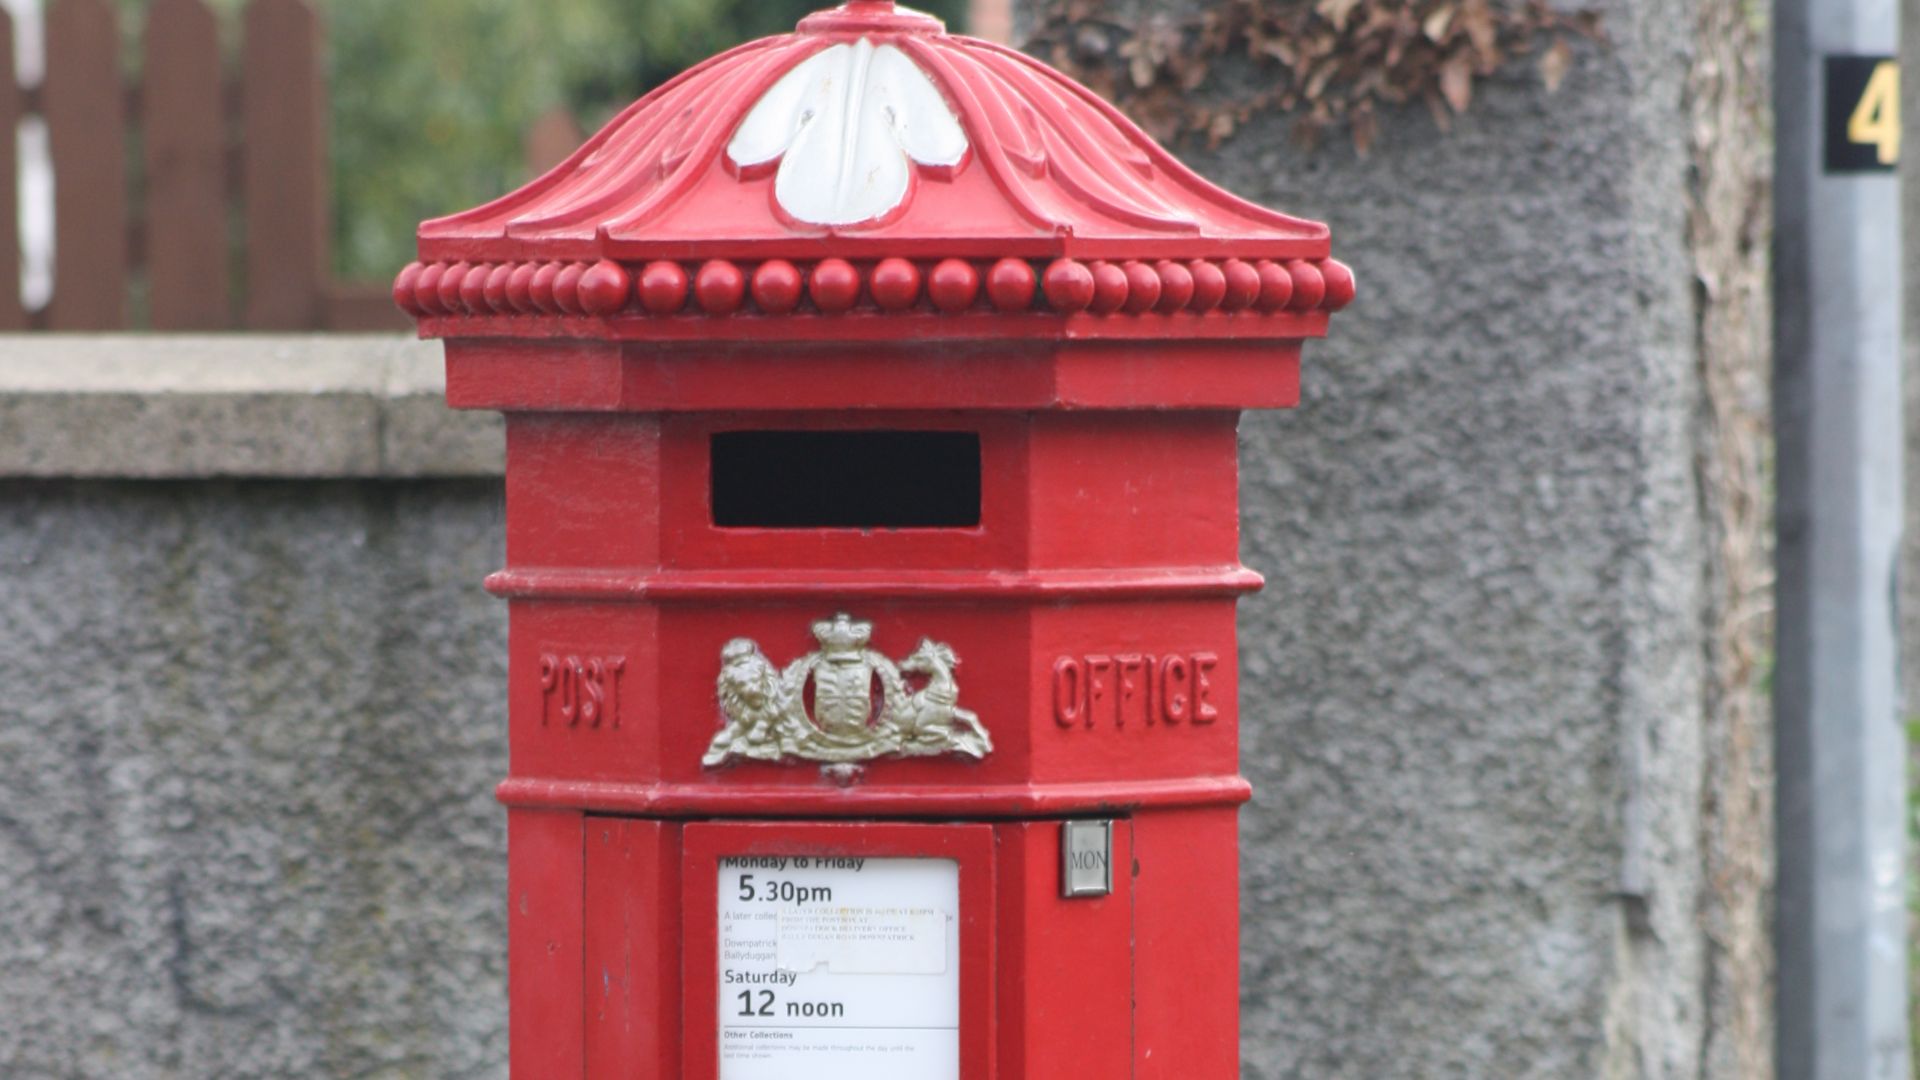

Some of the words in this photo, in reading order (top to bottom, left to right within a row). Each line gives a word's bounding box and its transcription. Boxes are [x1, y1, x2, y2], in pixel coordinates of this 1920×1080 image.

[1848, 59, 1901, 165] 4
[540, 653, 626, 730] POST
[1053, 652, 1218, 730] OFFICE
[725, 856, 788, 872] Monday
[793, 856, 809, 869] to
[815, 856, 865, 872] Friday
[1072, 850, 1106, 870] MON
[738, 874, 832, 906] 5.30pm
[724, 969, 797, 987] Saturday
[737, 989, 775, 1017] 12
[786, 1001, 844, 1017] noon
[723, 1031, 747, 1039] Other
[749, 1031, 793, 1039] Collections
